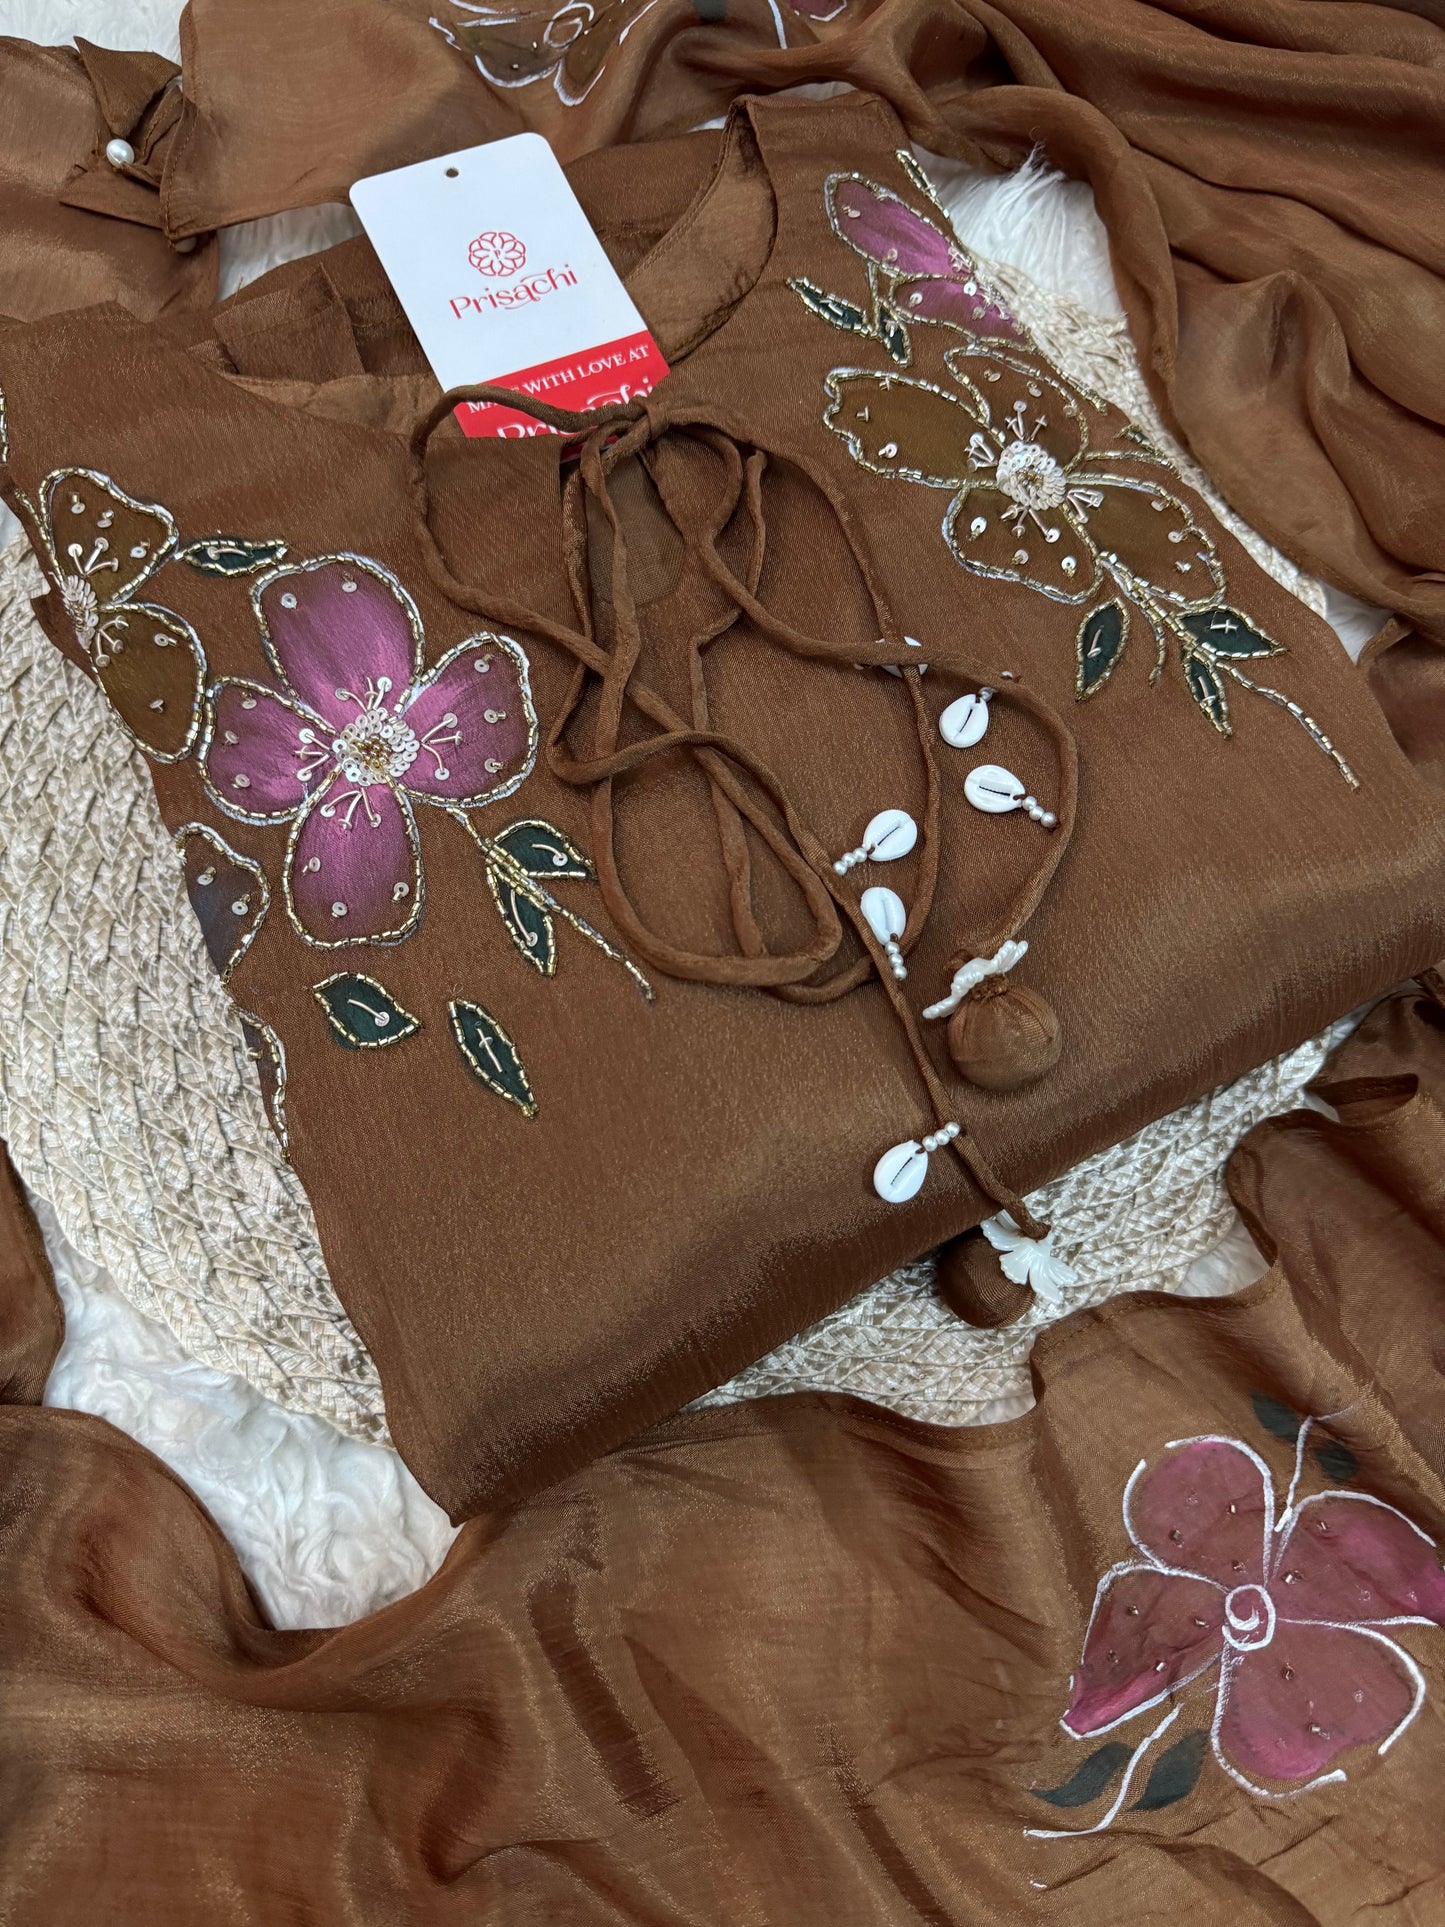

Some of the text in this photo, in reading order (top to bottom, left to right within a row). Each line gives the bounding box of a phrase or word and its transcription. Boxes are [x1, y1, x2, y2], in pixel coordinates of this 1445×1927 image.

[449, 263, 578, 320] Prisachi
[522, 345, 649, 395] WITH LOVE AT
